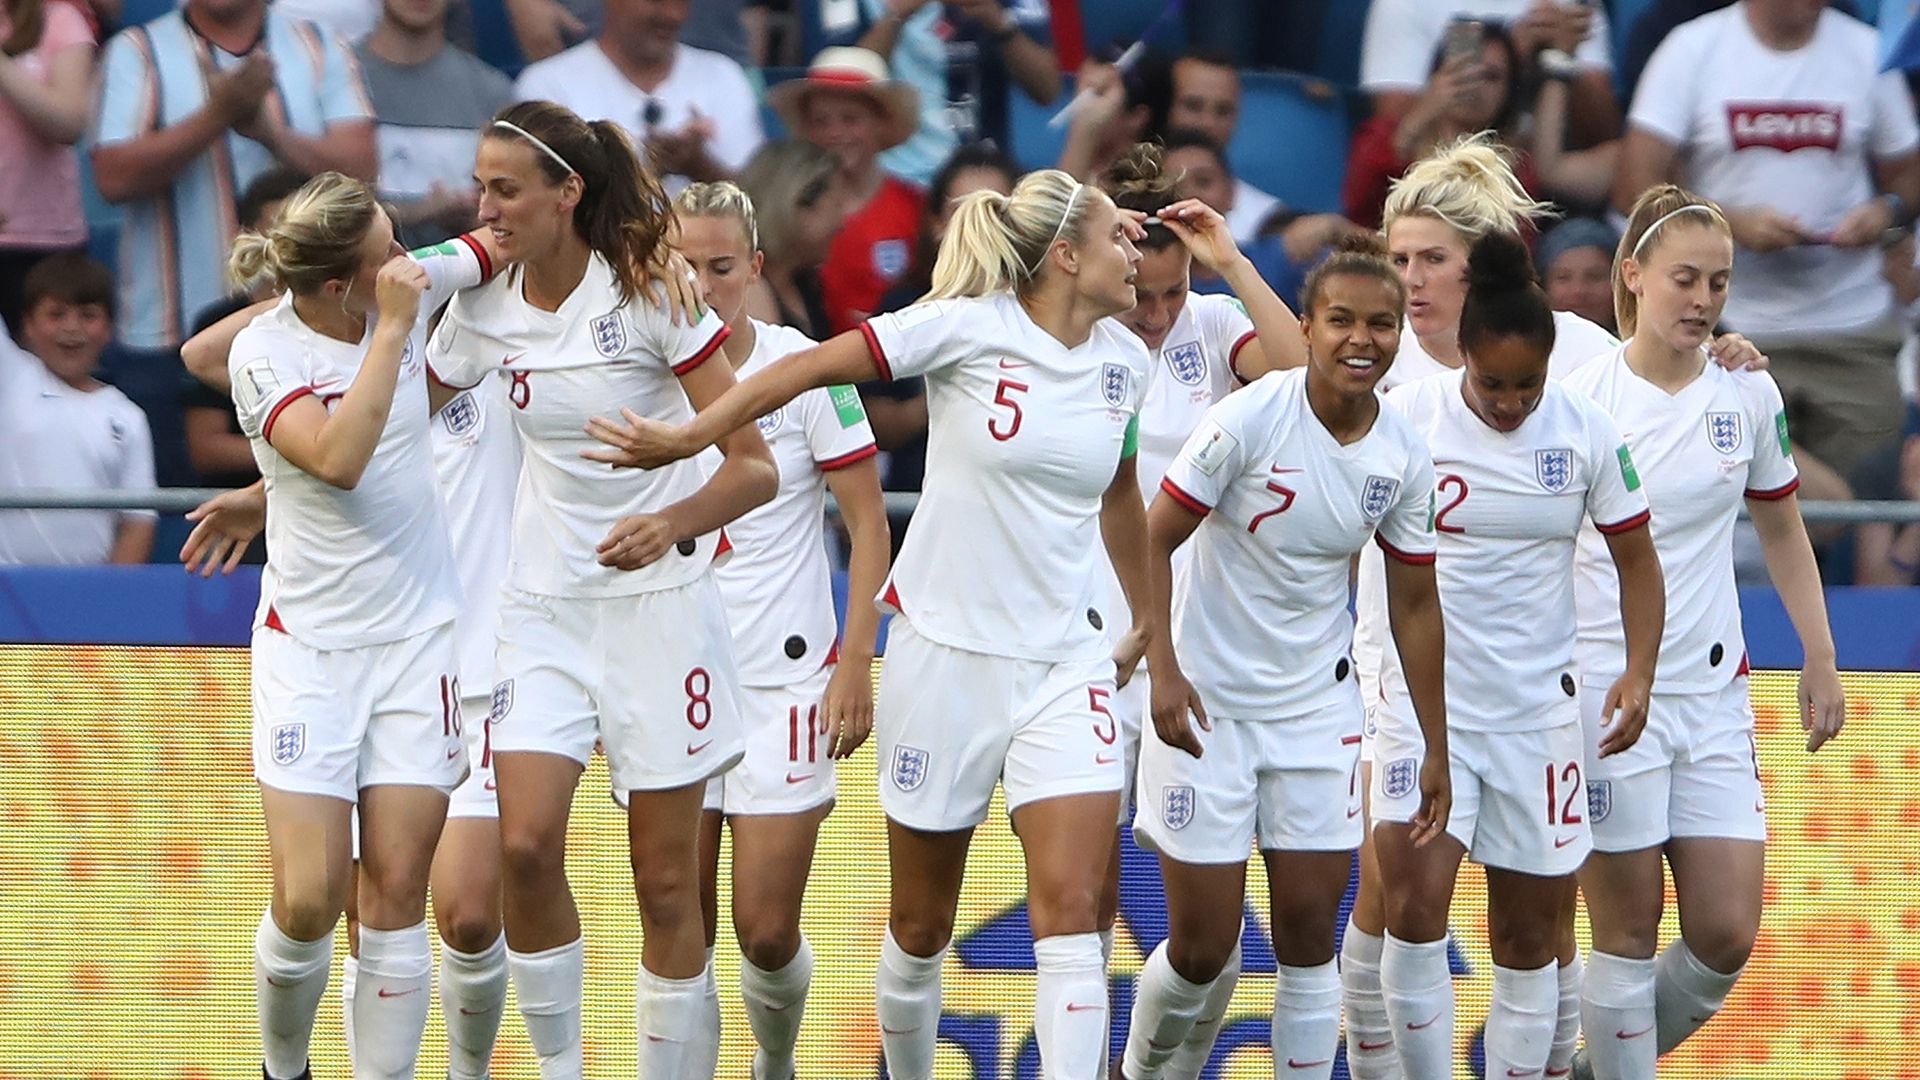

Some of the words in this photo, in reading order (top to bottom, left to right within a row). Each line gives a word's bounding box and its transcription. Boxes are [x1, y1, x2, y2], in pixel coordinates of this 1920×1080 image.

[510, 369, 530, 410] 8
[988, 378, 1028, 441] 5
[1247, 480, 1297, 534] 7
[441, 673, 461, 737] 18
[685, 667, 711, 730] 8
[1088, 685, 1116, 745] 5
[789, 703, 817, 763] 11
[1546, 761, 1582, 825] 12
